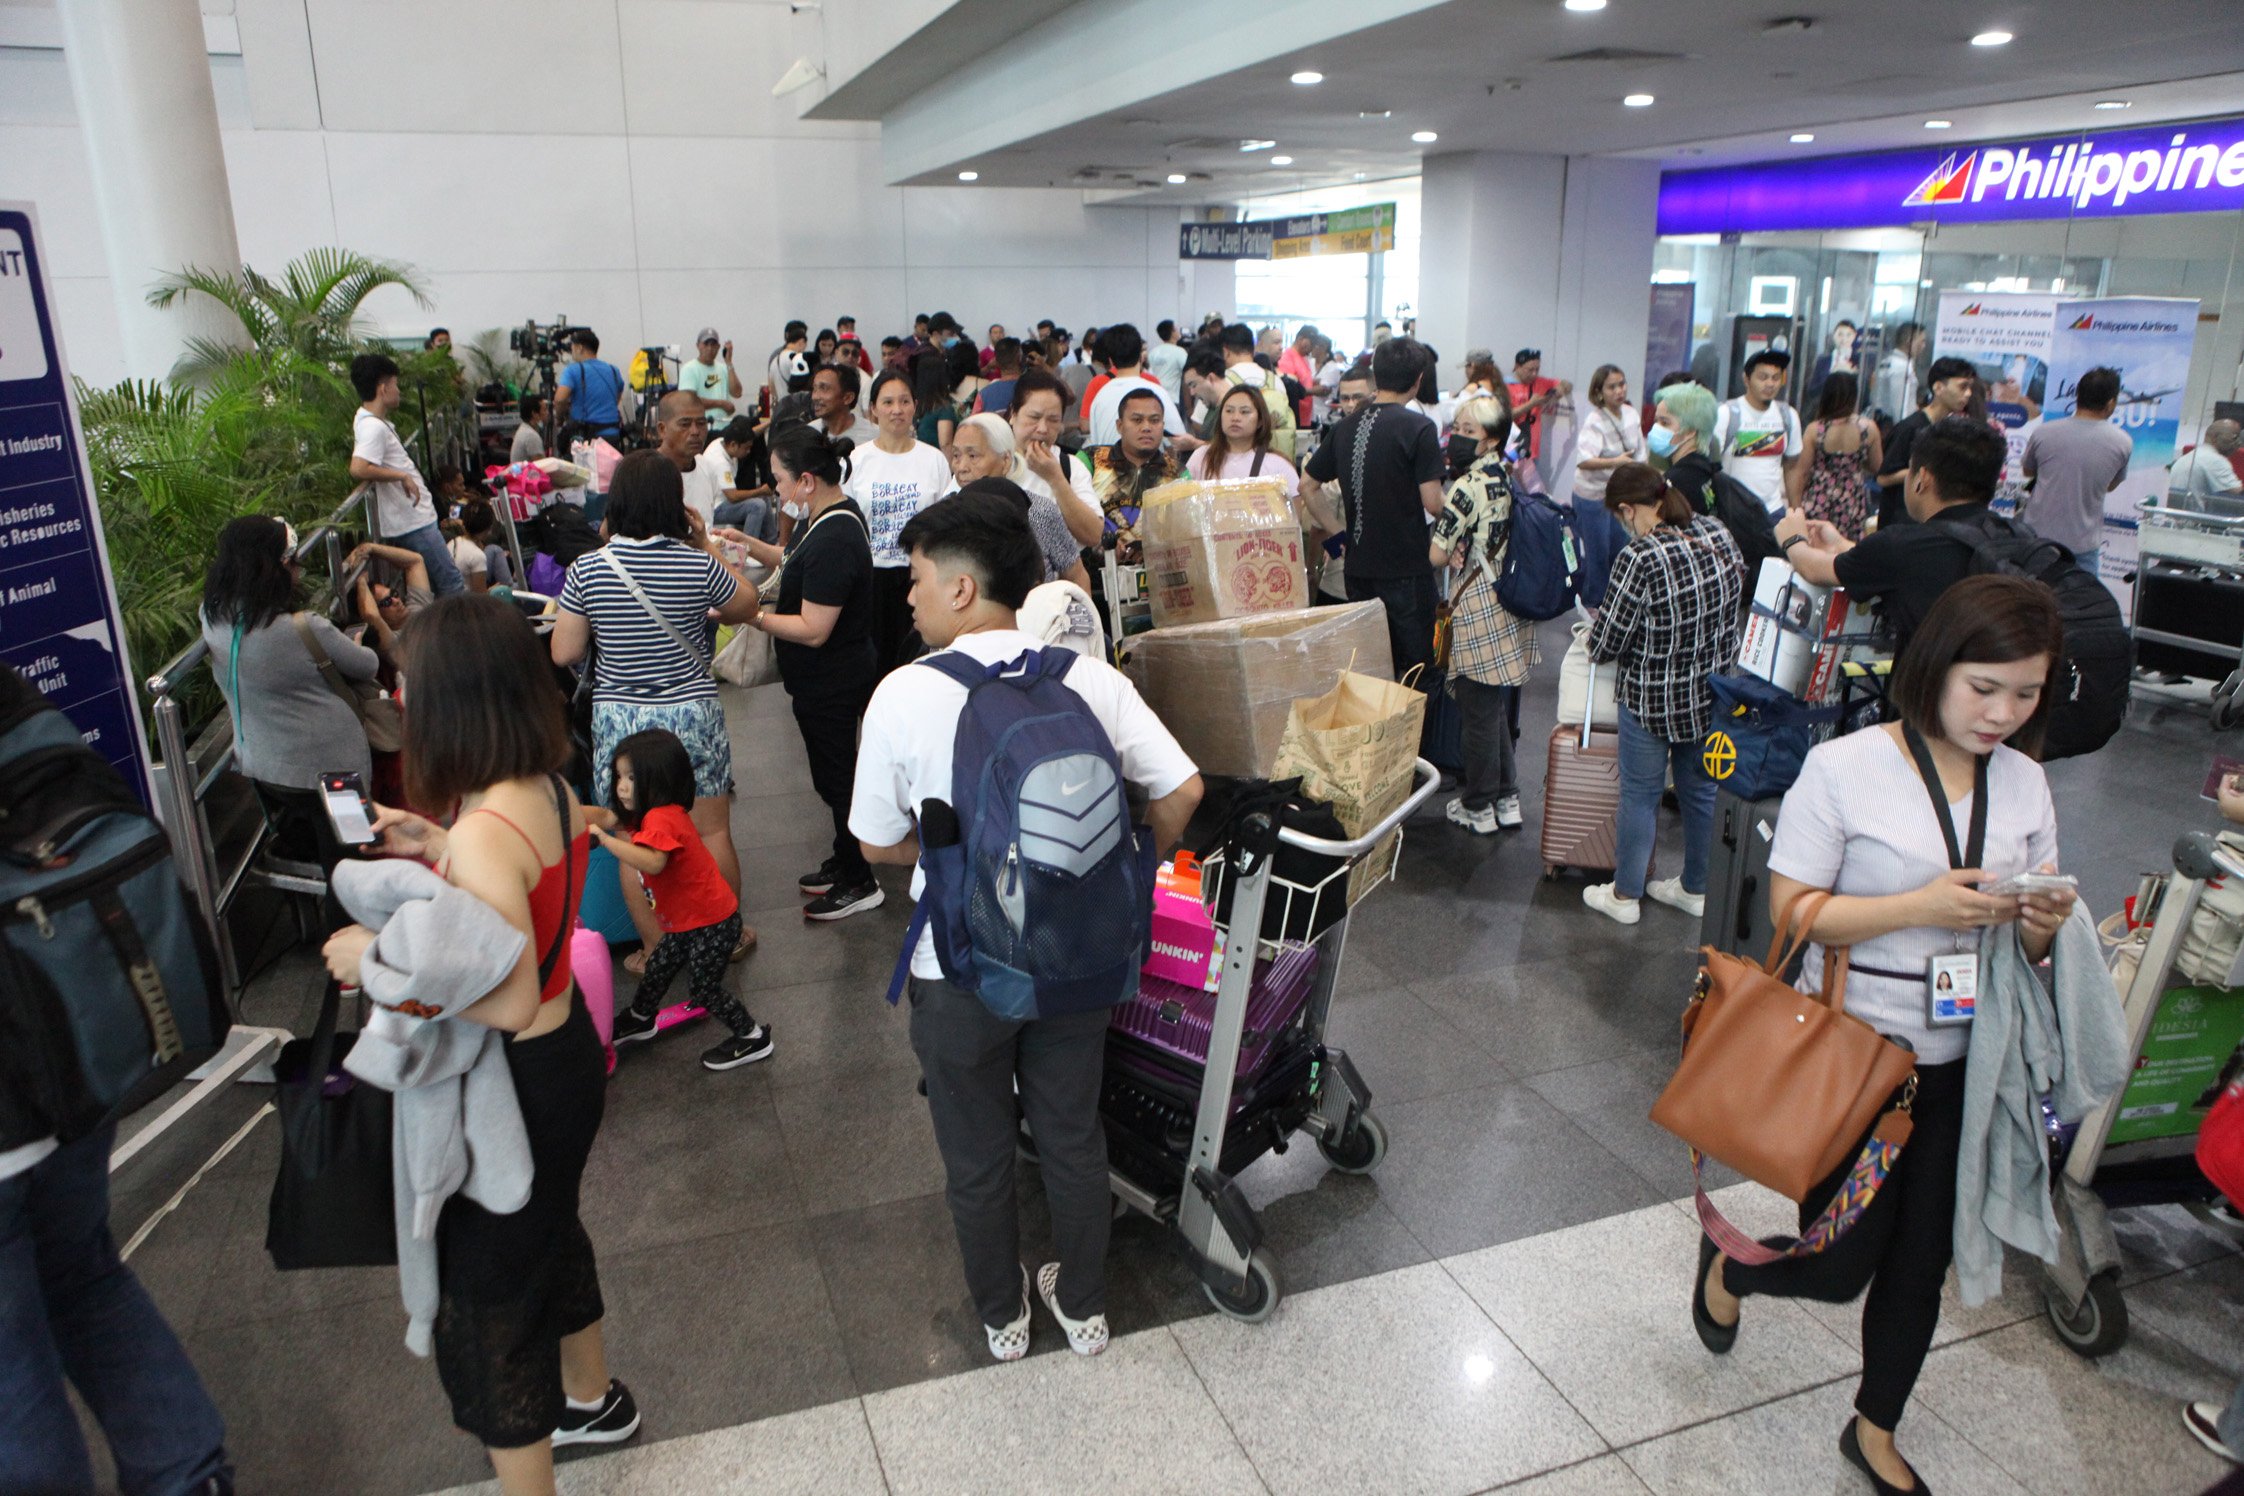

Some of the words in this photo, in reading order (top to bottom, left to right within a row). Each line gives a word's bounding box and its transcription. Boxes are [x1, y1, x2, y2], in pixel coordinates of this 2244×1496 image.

[1971, 133, 2244, 209] Philippine
[2092, 320, 2138, 333] Philippine
[2139, 321, 2178, 332] Airlines
[8, 434, 62, 455] Industry
[0, 502, 55, 526] isheries
[10, 518, 82, 545] Resources
[8, 576, 57, 605] Animal
[13, 655, 60, 680] Traffic
[37, 672, 68, 695] Unit
[1151, 939, 1204, 964] UNKIN'
